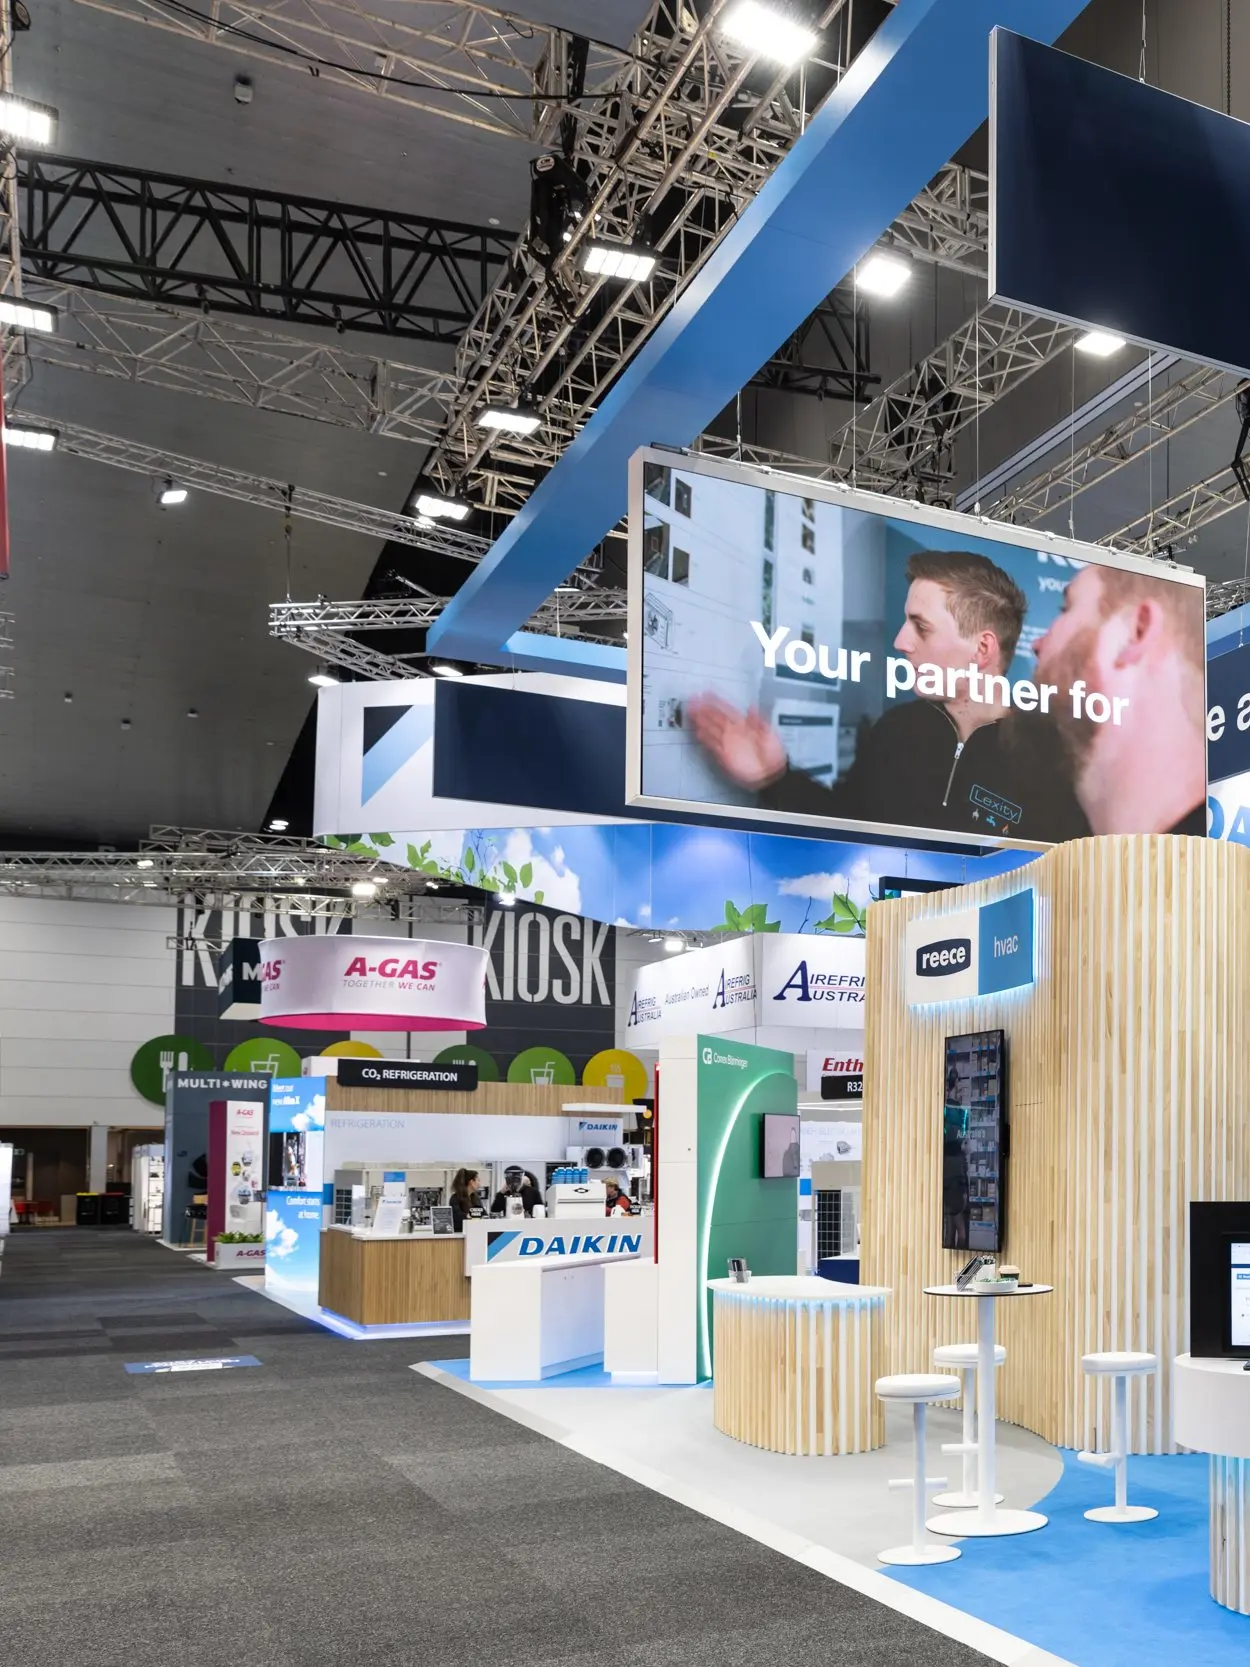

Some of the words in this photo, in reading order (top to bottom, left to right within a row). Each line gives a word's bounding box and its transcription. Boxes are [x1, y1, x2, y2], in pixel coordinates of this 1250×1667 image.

[750, 620, 870, 683] Your
[885, 655, 1057, 714] partner
[1069, 679, 1130, 725] for
[974, 790, 1018, 820] Lexity
[473, 910, 611, 1005] KIOSK
[922, 946, 966, 969] reece
[994, 935, 1019, 958] hvac
[343, 980, 395, 989] TOGETHER
[398, 982, 414, 990] WE
[417, 983, 435, 991] CAN
[383, 1069, 458, 1082] REFRIGERATION
[330, 1119, 405, 1129] REFRIGERATION
[587, 1123, 618, 1131] DAIKIN
[519, 1235, 642, 1256] DAIKIN
